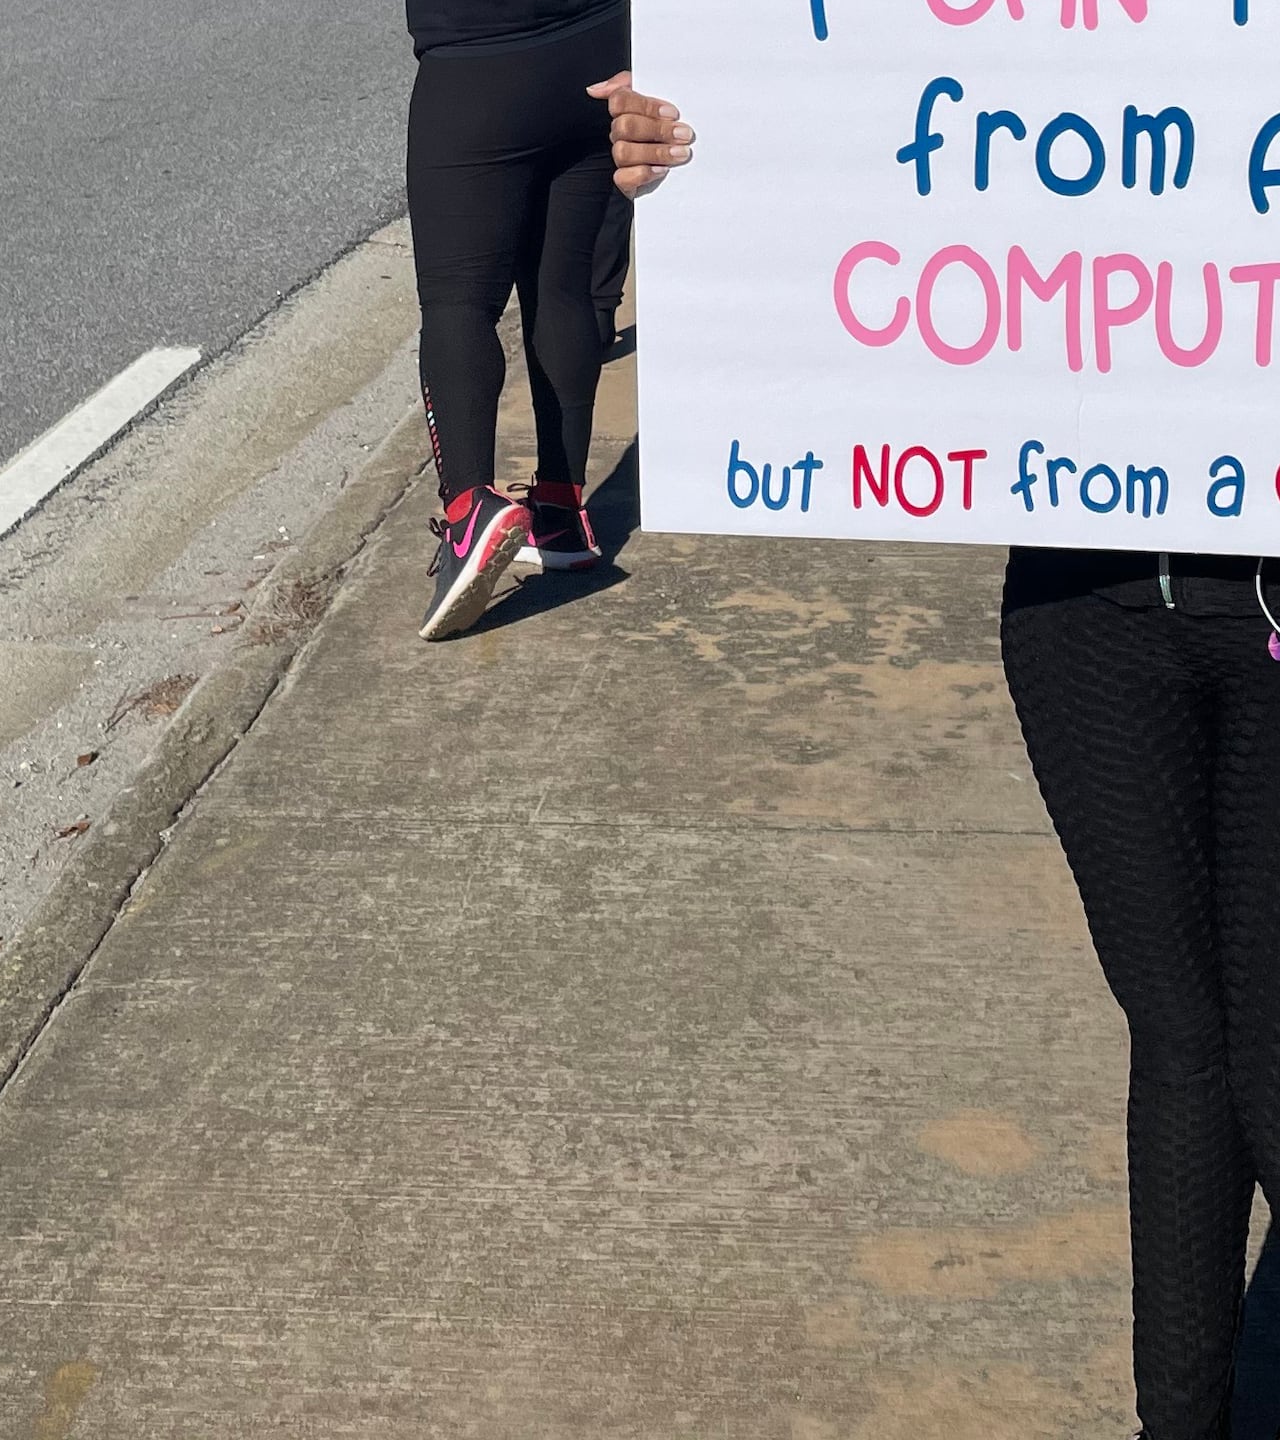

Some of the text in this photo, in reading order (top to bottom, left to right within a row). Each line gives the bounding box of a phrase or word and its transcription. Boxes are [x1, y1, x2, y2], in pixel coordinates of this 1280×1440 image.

[896, 76, 1196, 198] from
[727, 439, 825, 513] but
[852, 443, 989, 519] NOT
[1010, 439, 1170, 518] from
[1206, 455, 1246, 519] a
